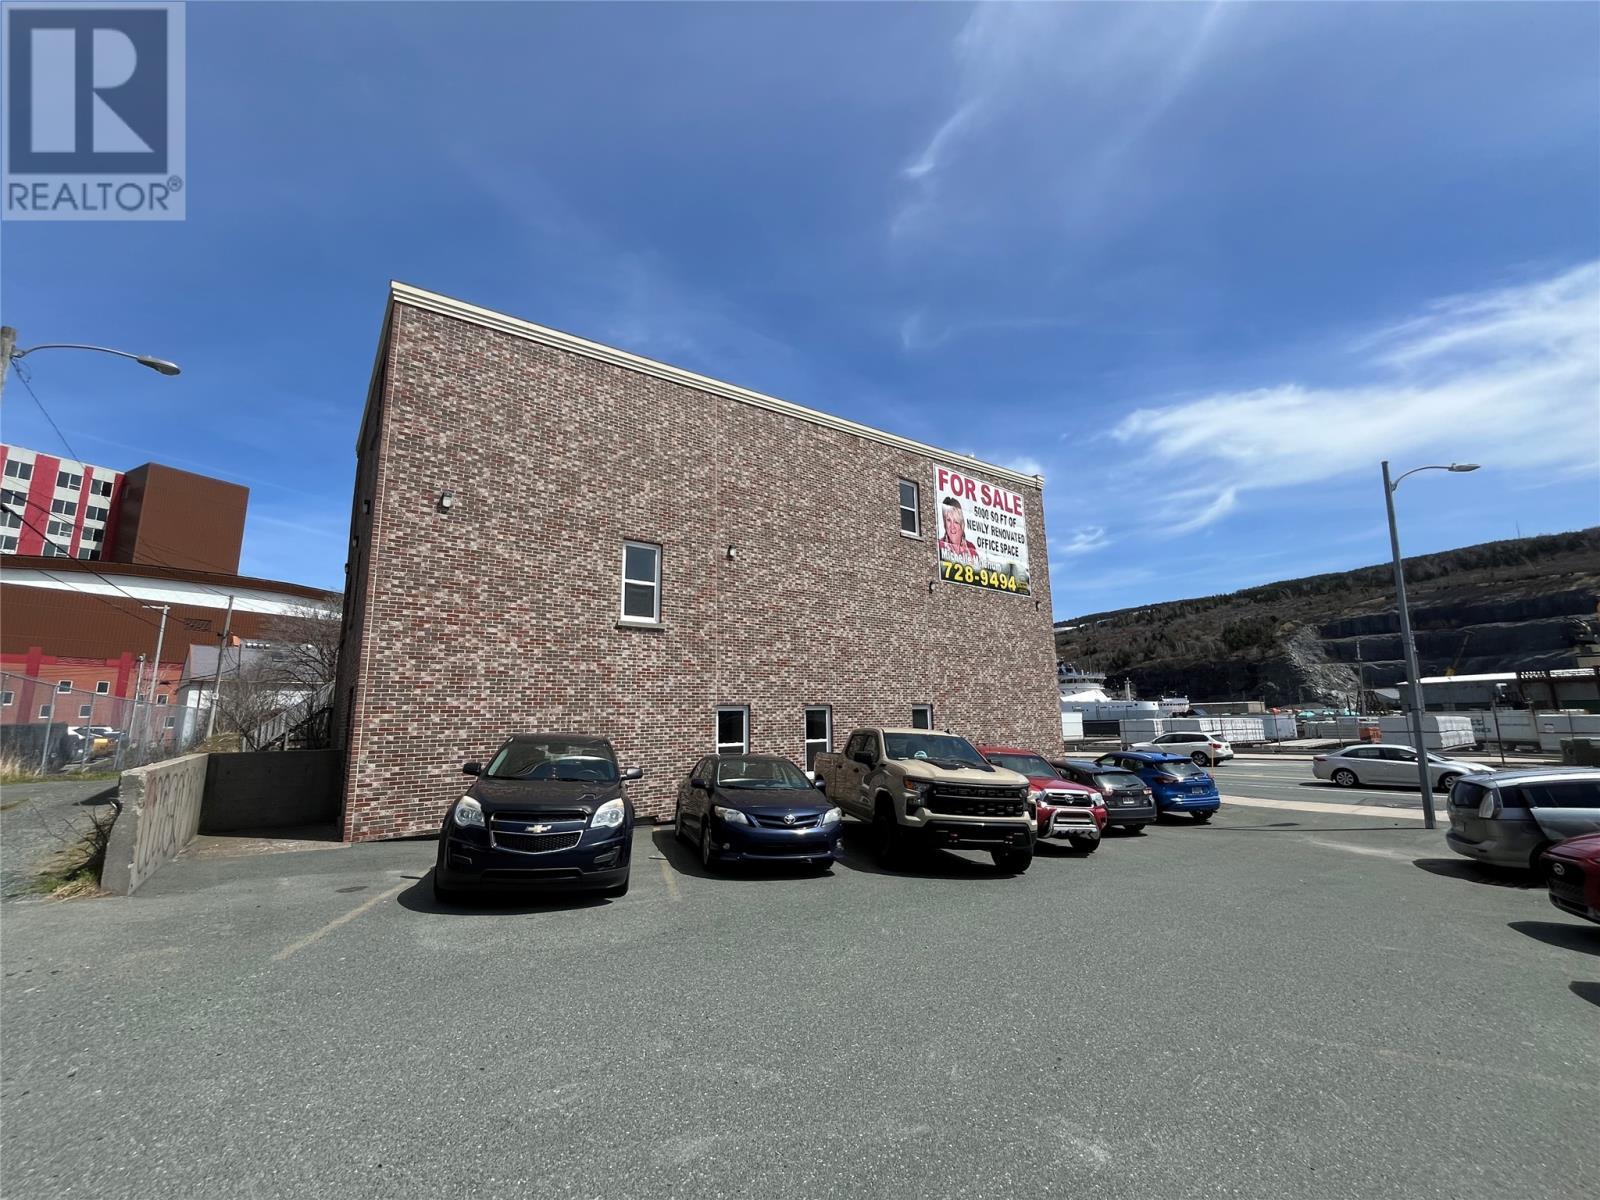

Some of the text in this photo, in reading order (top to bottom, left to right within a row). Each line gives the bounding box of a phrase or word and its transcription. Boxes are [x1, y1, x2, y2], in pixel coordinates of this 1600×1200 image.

[938, 468, 1023, 517] FOR SALE
[974, 506, 1017, 528] 5000 SQ FT OF
[966, 518, 1025, 544] NEWLY RENOVATED
[977, 536, 1019, 557] OFFICE SPACE
[942, 560, 1017, 592] 728-9494
